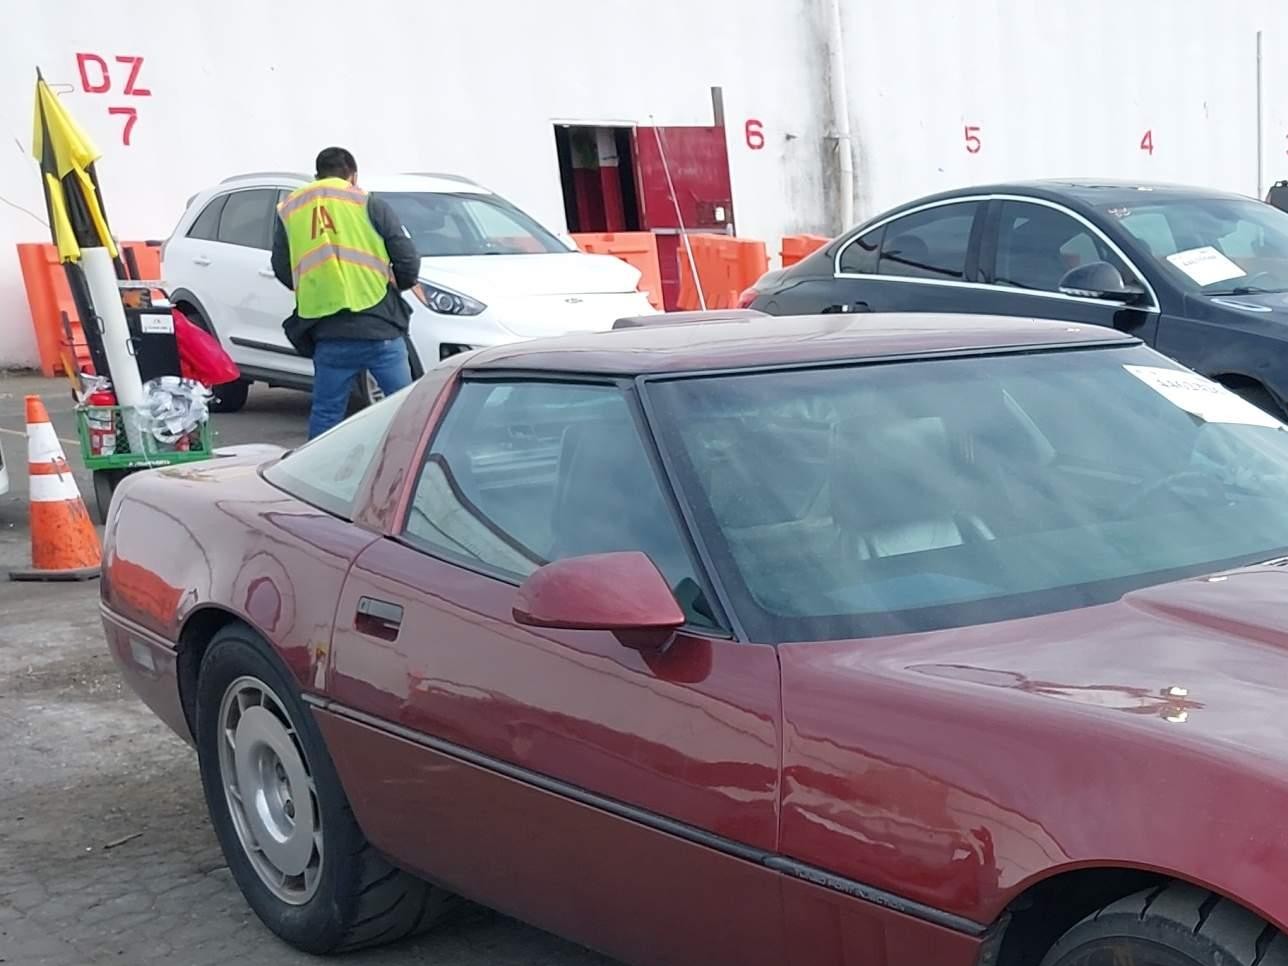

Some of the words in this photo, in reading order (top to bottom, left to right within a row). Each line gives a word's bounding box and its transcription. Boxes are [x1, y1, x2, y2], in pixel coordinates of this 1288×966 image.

[76, 53, 152, 95] DZ
[108, 107, 137, 146] 7
[745, 119, 764, 150] 6
[964, 126, 981, 153] 5
[1140, 130, 1153, 155] 4
